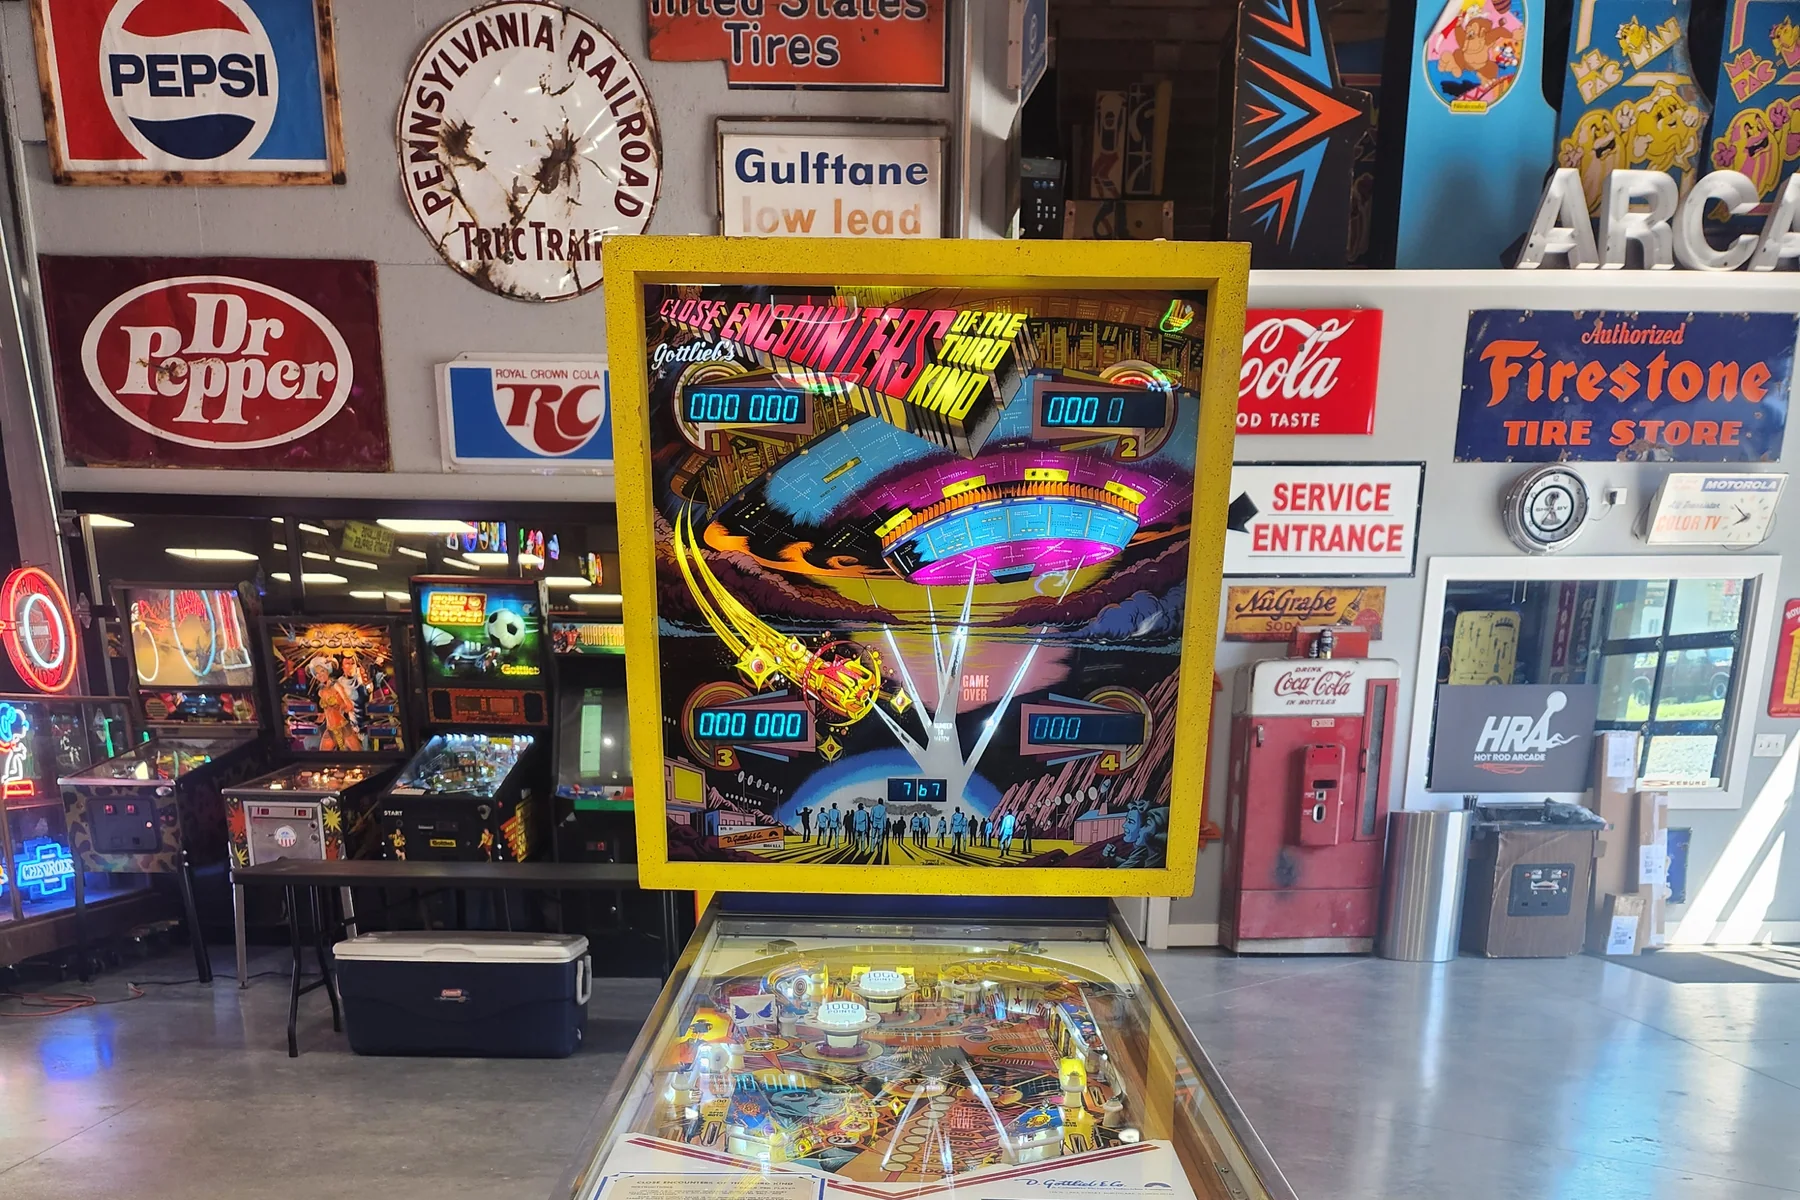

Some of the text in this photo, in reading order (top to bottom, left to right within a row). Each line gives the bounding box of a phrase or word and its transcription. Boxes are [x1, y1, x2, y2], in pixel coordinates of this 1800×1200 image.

[723, 22, 840, 67] Tires
[108, 53, 270, 98] PEPSI
[408, 12, 651, 219] PENNSYLVANIA RAILROAD
[734, 148, 929, 187] Gulftane
[742, 196, 922, 236] low lead
[187, 293, 284, 356] Dr
[1581, 321, 1687, 346] Authorized
[651, 340, 735, 370] Gottlieb's
[659, 299, 1028, 400] CLOSE ENCOUNTERS OF THE
[937, 334, 1011, 371] THIRD
[116, 326, 338, 425] Pepper
[495, 369, 600, 379] ROYAL CROWN COLA
[1479, 340, 1772, 407] Firestone
[906, 362, 990, 420] KIND
[496, 384, 601, 453] RC
[1270, 413, 1321, 428] TASTE
[1503, 419, 1743, 446] TIRE STORE
[1121, 437, 1137, 458] 2
[1272, 483, 1392, 512] SERVICE
[1705, 480, 1778, 489] MOTOROLA
[1252, 523, 1404, 552] ENTRANCE
[1656, 515, 1722, 532] COLOR TV
[962, 674, 990, 688] GAME
[963, 688, 988, 701] OVER
[1274, 671, 1355, 697] Coca-Cola
[1475, 714, 1553, 752] HRA
[717, 748, 733, 766] 3
[1100, 754, 1119, 772] 4
[1044, 1178, 1097, 1189] Gottlieb
